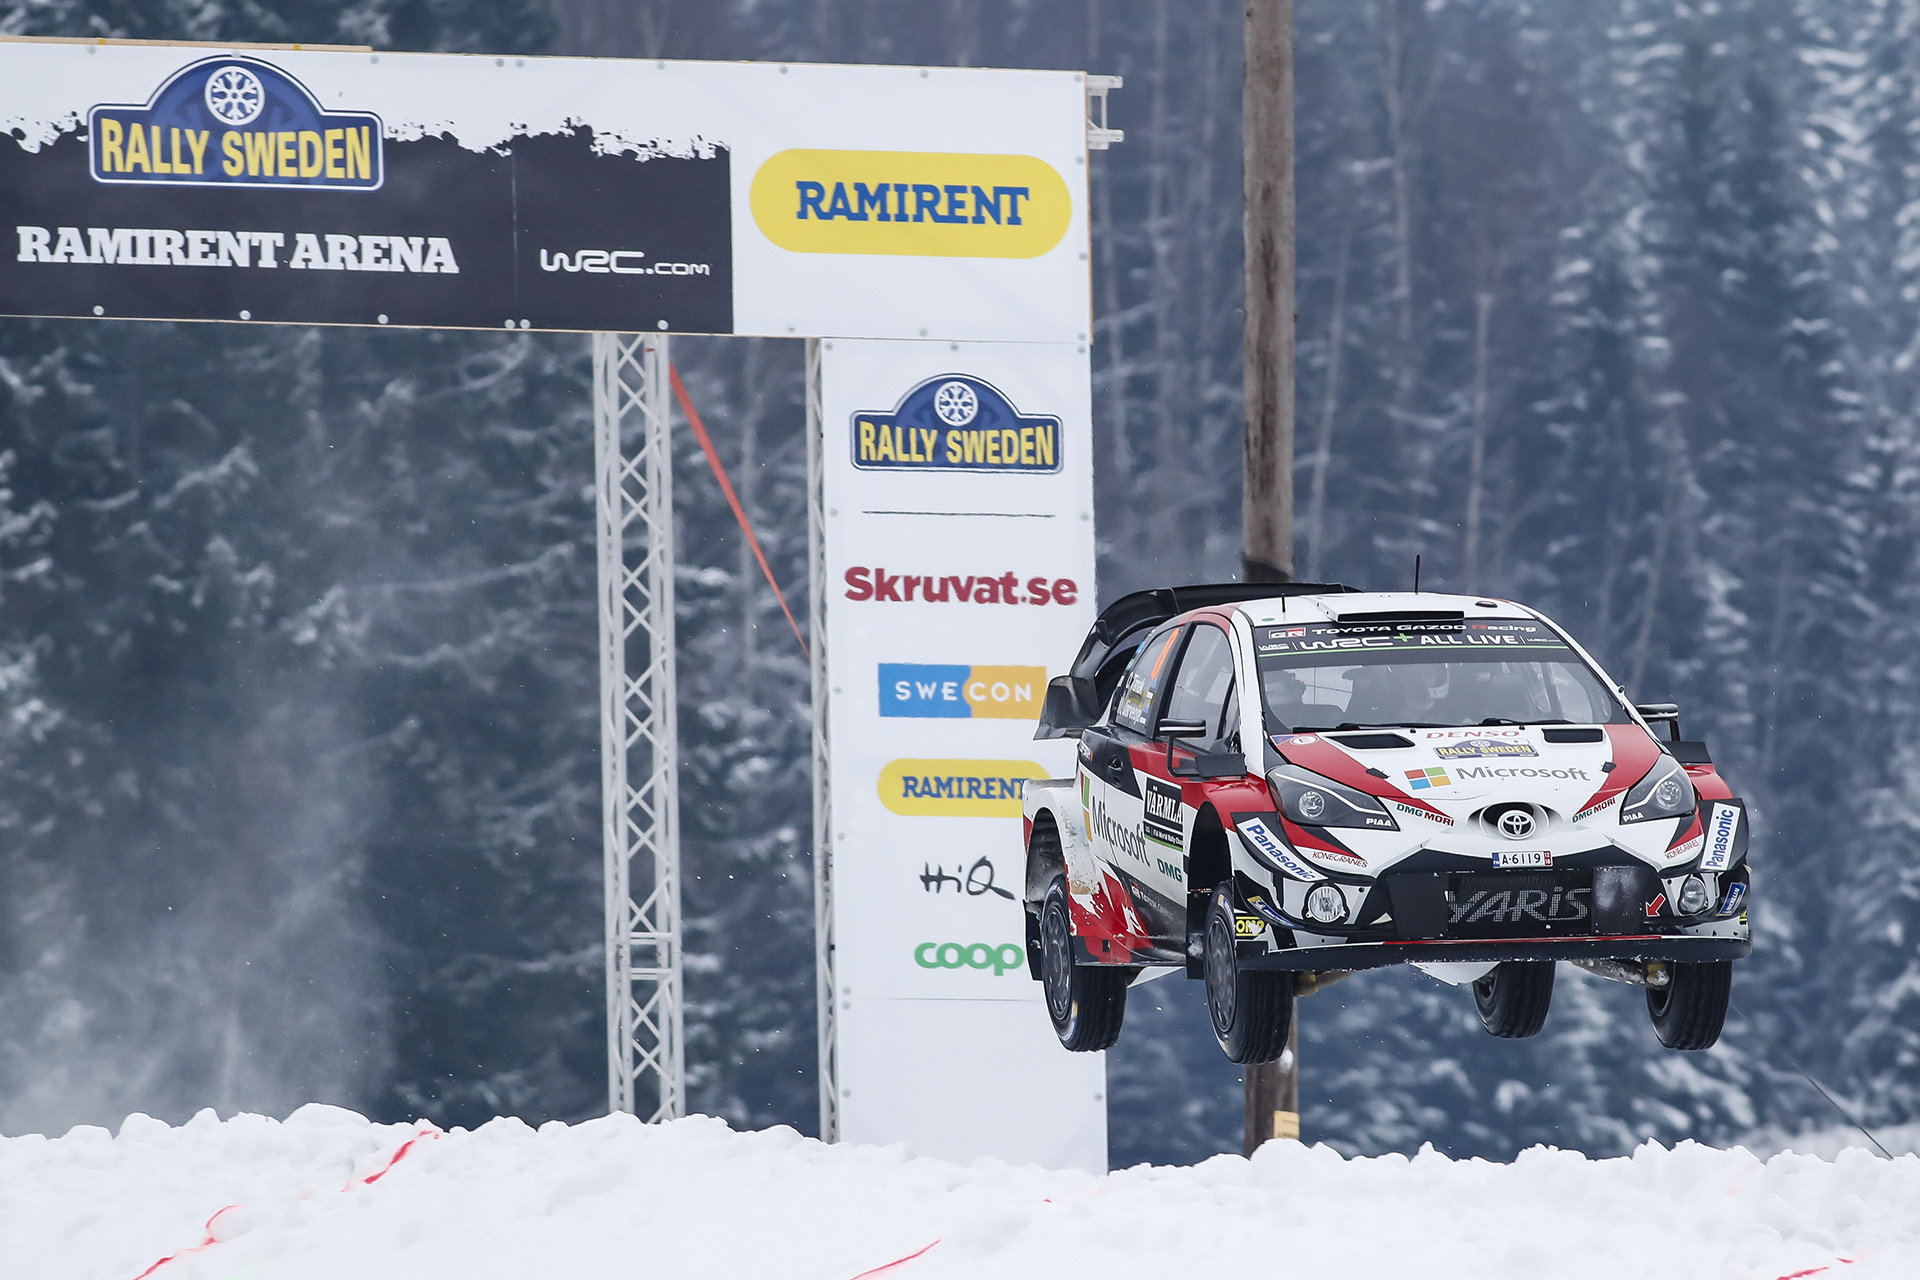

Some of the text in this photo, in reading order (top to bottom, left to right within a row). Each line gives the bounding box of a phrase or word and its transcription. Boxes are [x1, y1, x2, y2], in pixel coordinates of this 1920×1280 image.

[101, 118, 371, 180] RALLY SWEDEN
[795, 180, 1029, 225] RAMIRENT
[16, 225, 460, 274] RAMIRENT ARENA
[859, 421, 1054, 466] RALLY SWEDEN
[844, 566, 1078, 605] Skruvat.se
[1311, 626, 1391, 634] TOYOTA
[1472, 624, 1537, 632] Racing
[1420, 635, 1463, 644] ALL
[1466, 635, 1518, 644] LIVE
[896, 681, 1032, 702] SWECON
[1426, 731, 1520, 739] DENSO
[1439, 745, 1532, 756] RALLY SWEDEN
[1456, 766, 1591, 782] Microsoft
[1365, 818, 1391, 827] PIAA
[1396, 803, 1455, 827] DMG MORI
[1572, 797, 1616, 823] DMG MORI
[1622, 812, 1644, 822] PIAA
[1092, 795, 1150, 867] Microsoft
[1705, 809, 1734, 867] Panasonic
[1246, 824, 1316, 880] Panasonic
[1312, 851, 1369, 868] KONECRANES
[919, 856, 1016, 900] HiQ
[1157, 858, 1182, 882] DMG
[914, 942, 1024, 976] coop
